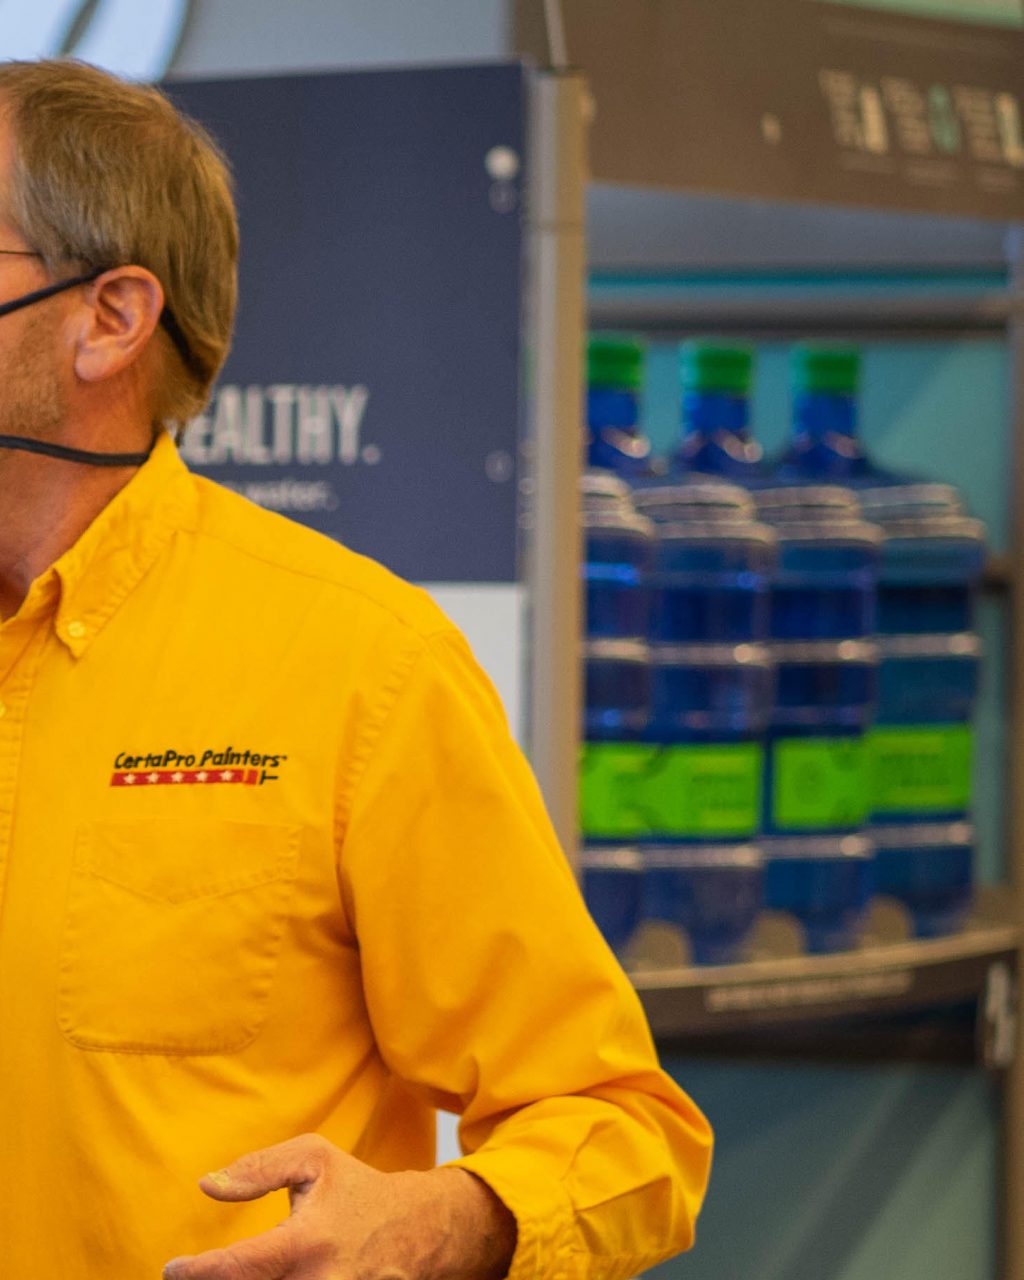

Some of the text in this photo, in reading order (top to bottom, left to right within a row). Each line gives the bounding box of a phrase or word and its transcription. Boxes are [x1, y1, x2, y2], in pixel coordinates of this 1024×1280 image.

[179, 384, 382, 465] EALTHY.
[114, 747, 280, 769] CertaPro Painters
